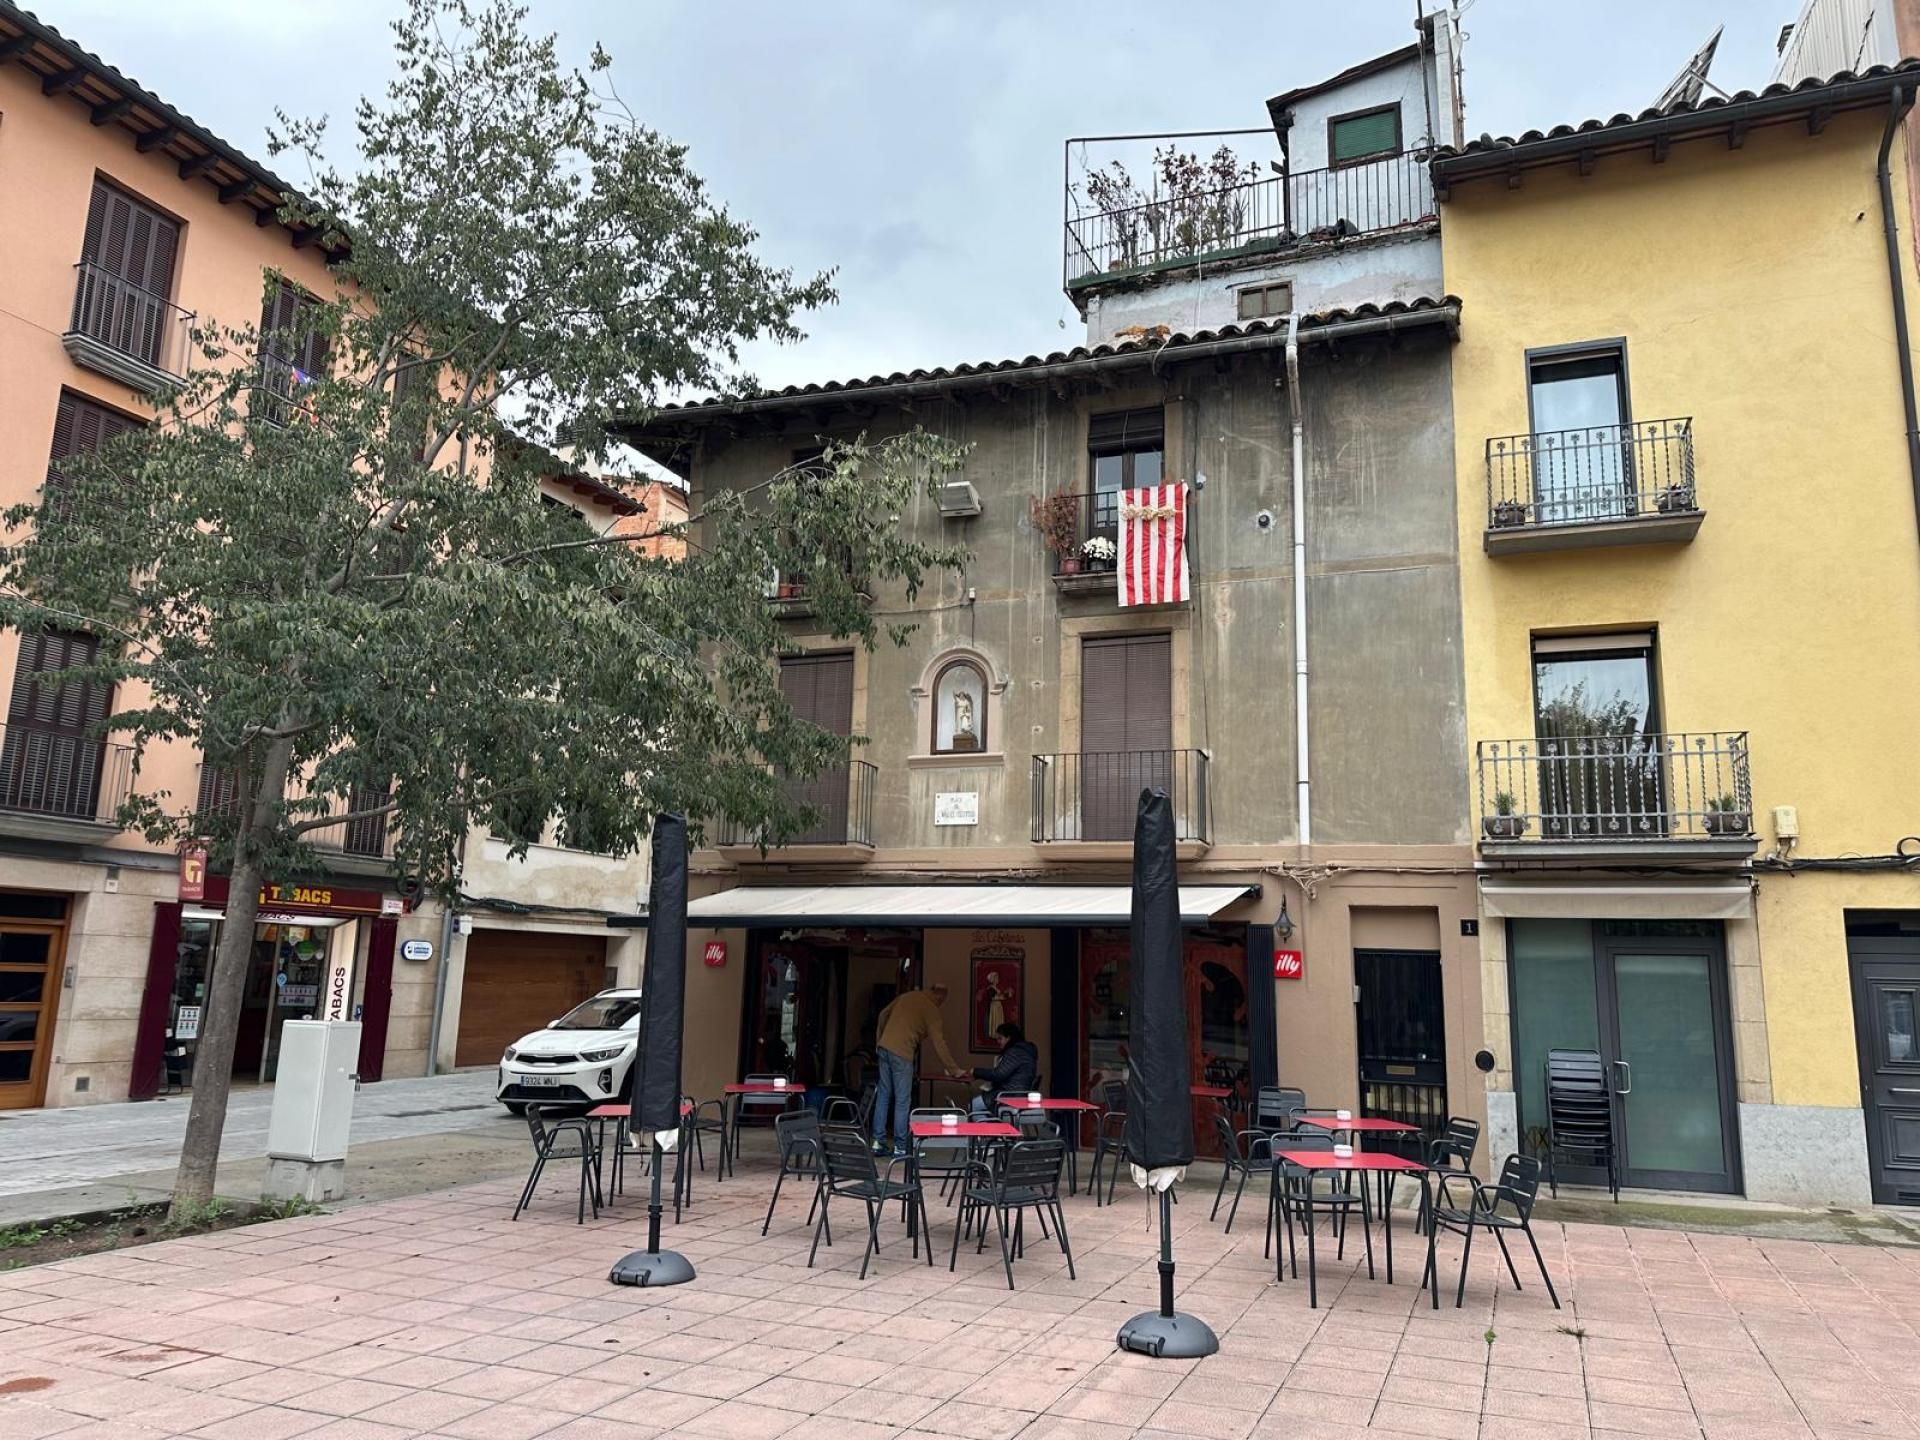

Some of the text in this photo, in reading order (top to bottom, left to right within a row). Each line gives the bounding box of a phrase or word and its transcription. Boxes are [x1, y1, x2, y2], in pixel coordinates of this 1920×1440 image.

[270, 886, 332, 905] TBACS
[1465, 922, 1473, 934] 1
[706, 944, 725, 965] illy
[1276, 954, 1300, 975] illy
[329, 967, 346, 1021] ABACS
